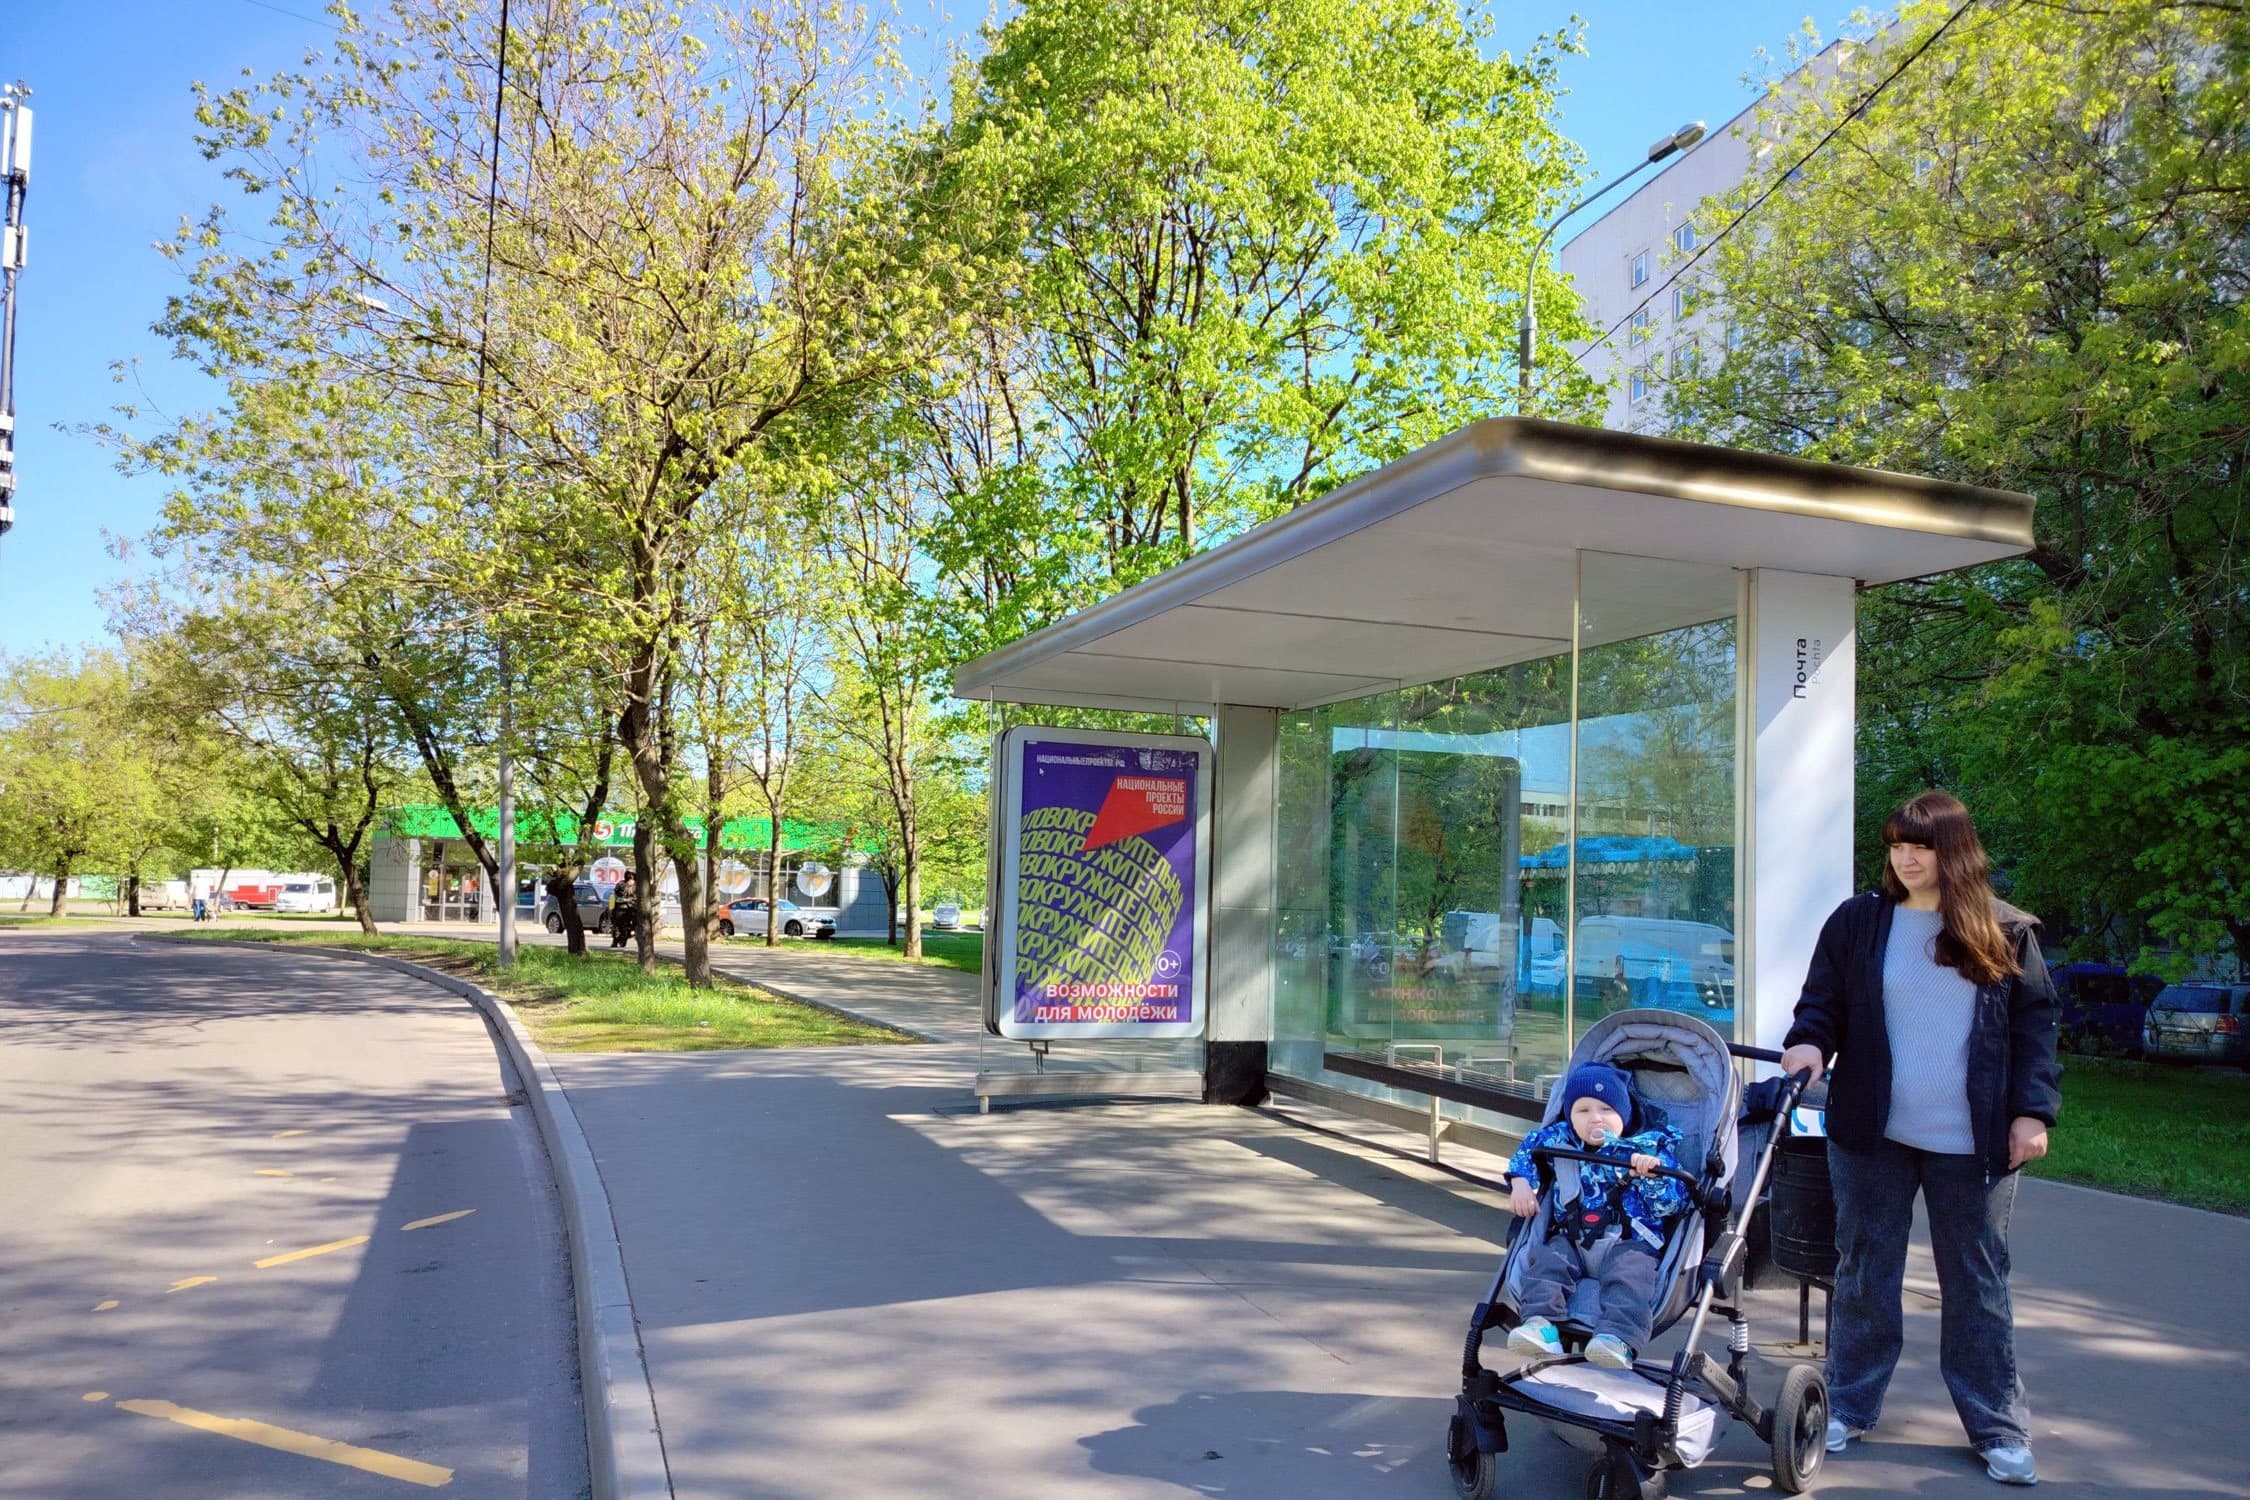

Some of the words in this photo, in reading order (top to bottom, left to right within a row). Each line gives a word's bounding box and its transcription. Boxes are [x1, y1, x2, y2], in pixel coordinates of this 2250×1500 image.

[1794, 638, 1806, 698] Почта
[1116, 778, 1184, 792] НАЦИОНАЛЬНЫЕ
[1145, 791, 1184, 804] ПРОЕКТЫ
[1152, 804, 1184, 816] РОССИИ
[1157, 957, 1179, 972] 0+
